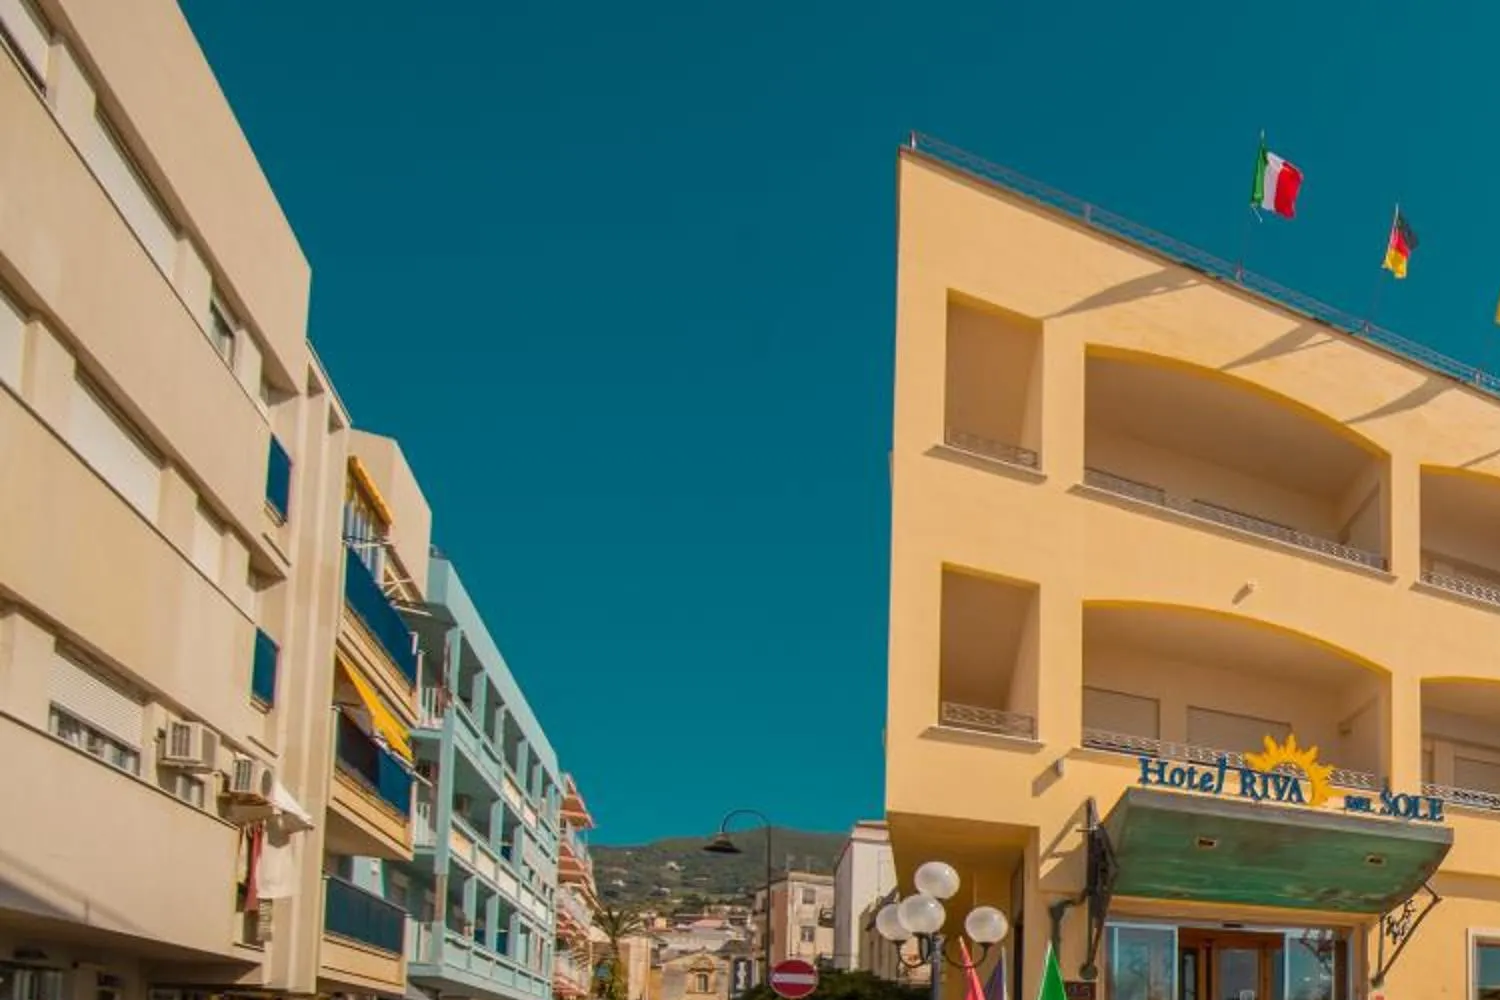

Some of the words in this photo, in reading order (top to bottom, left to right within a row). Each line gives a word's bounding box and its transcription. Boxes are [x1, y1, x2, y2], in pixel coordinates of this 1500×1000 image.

[1138, 752, 1227, 794] Hotel
[1239, 768, 1305, 803] RIVA
[1380, 781, 1444, 821] SOLE
